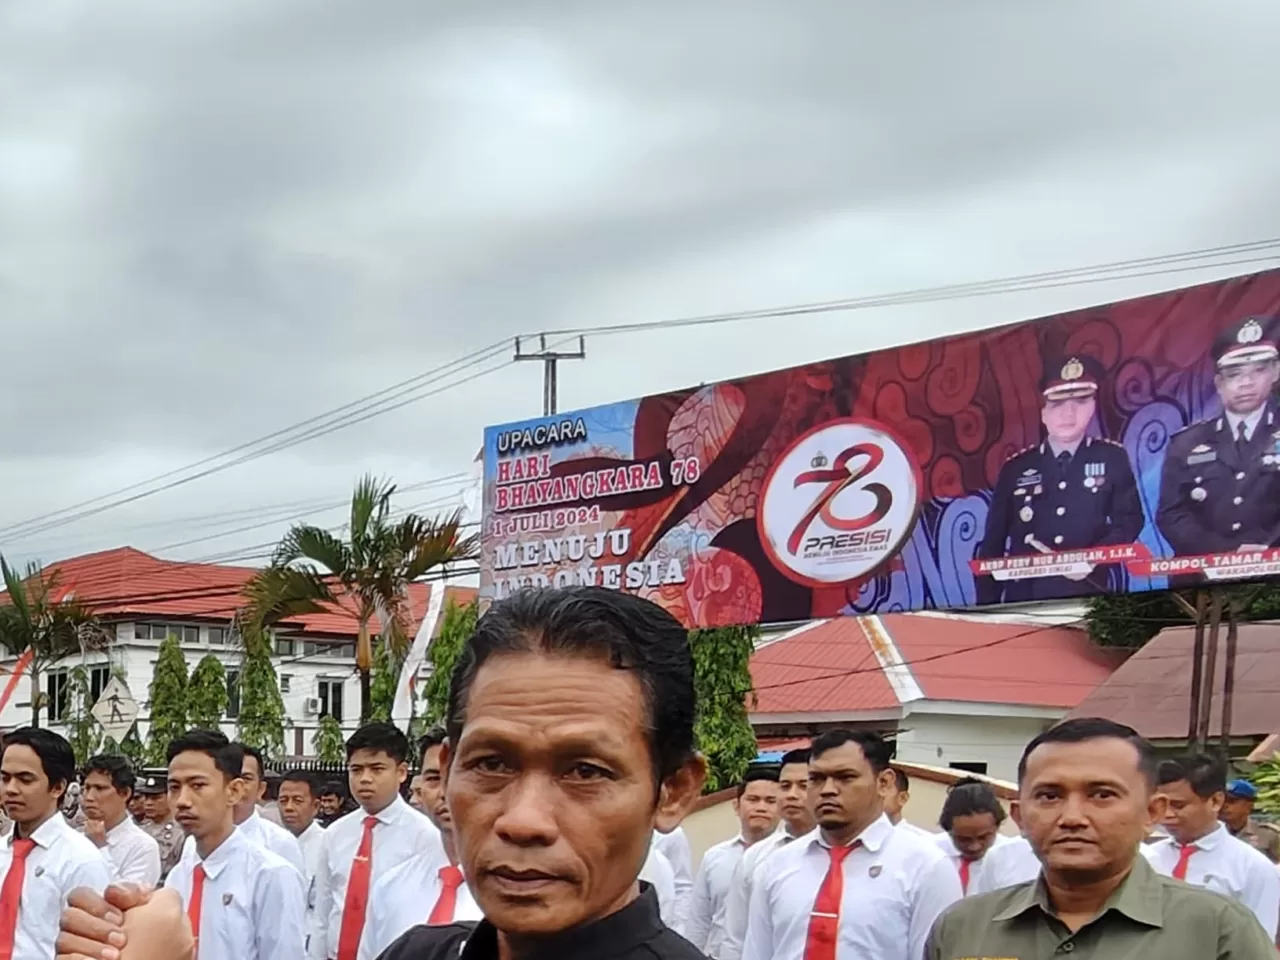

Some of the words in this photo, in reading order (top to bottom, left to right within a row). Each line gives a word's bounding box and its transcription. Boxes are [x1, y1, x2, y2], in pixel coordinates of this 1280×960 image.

[498, 419, 587, 452] UPACARA
[495, 462, 663, 510] BHAYANGKARA
[670, 456, 700, 486] 78
[497, 453, 551, 485] HARI
[494, 522, 503, 536] 1
[508, 513, 554, 533] JULI
[555, 505, 600, 526] 2024
[494, 528, 632, 570] MENUJU
[804, 528, 892, 552] PRESISI
[1151, 558, 1209, 573] KOMPOL
[1213, 552, 1268, 567] TAMAR,
[494, 558, 686, 600] INDONESIA
